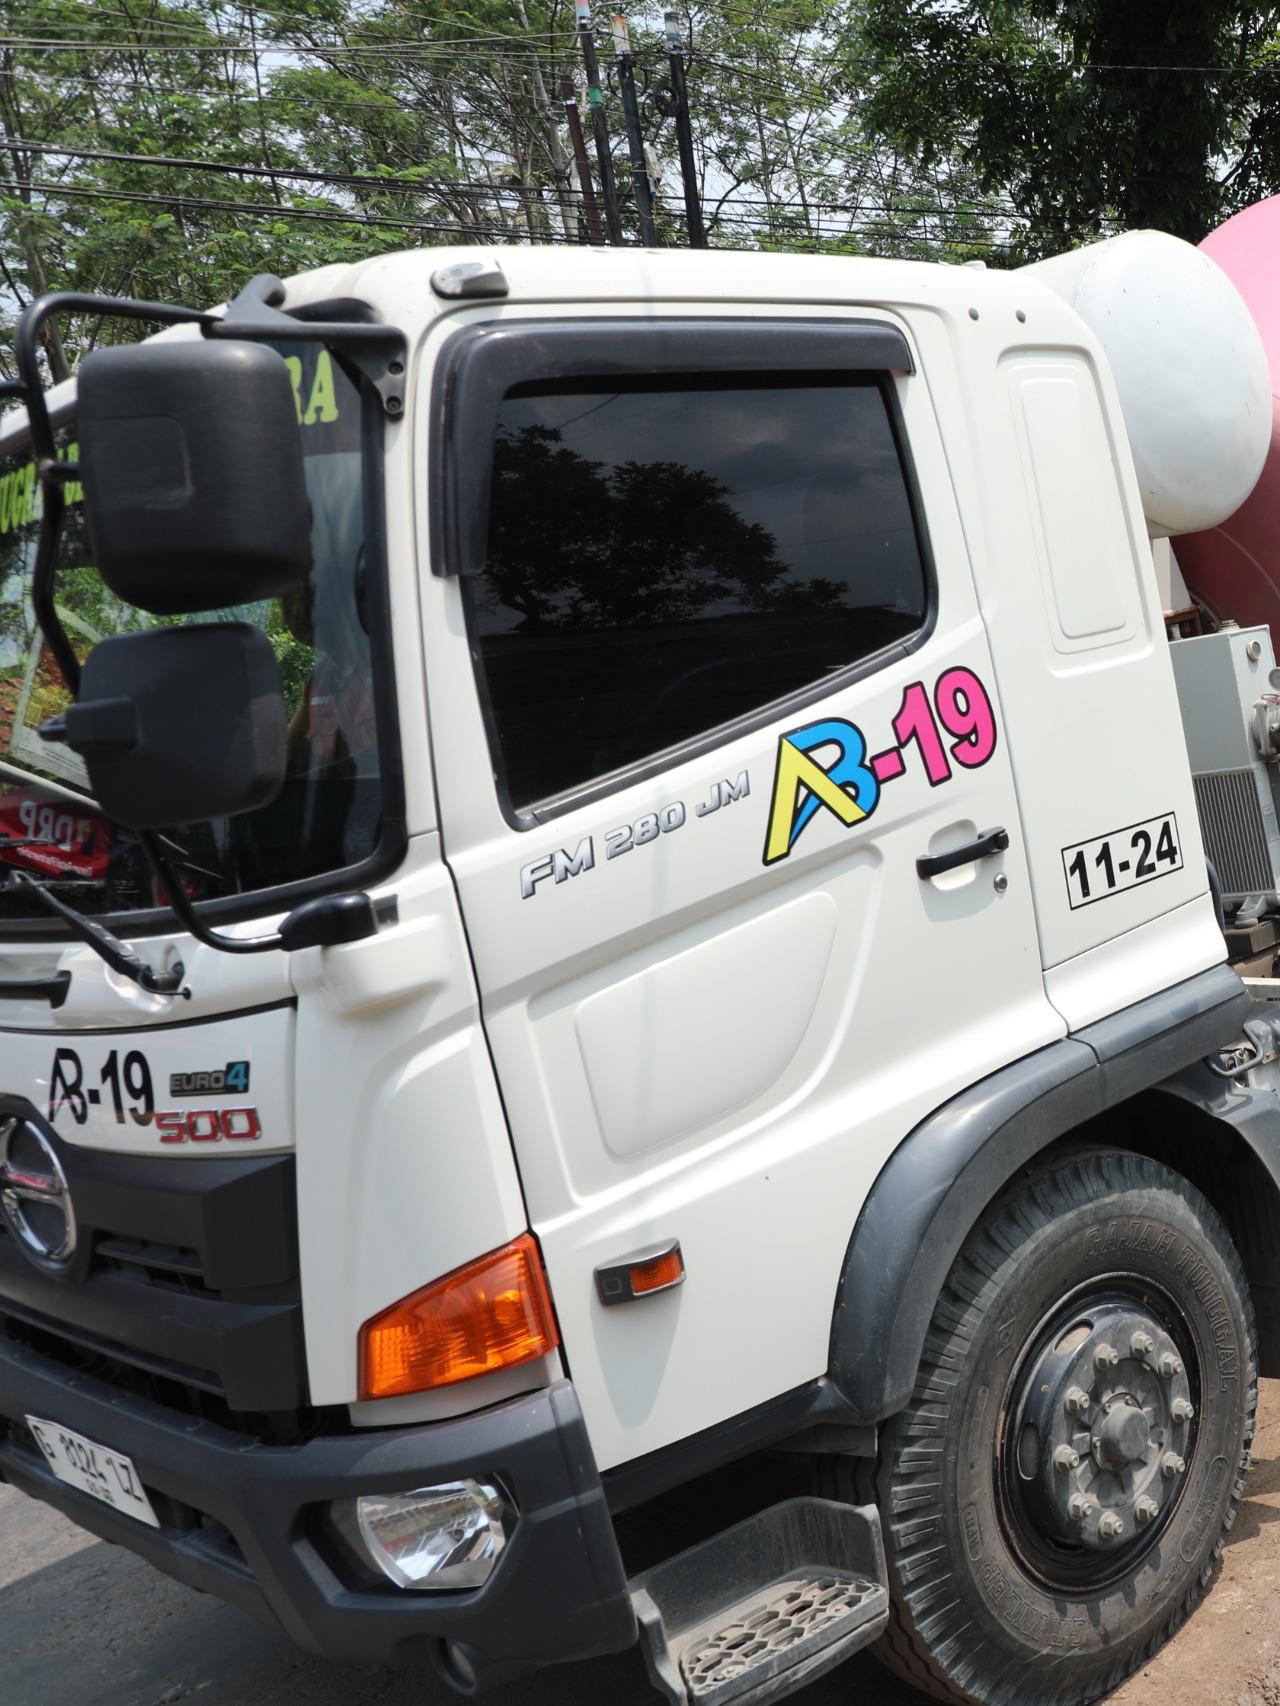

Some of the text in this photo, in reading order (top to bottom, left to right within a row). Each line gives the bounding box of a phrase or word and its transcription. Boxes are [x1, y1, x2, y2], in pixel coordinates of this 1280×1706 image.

[521, 770, 751, 900] FM 280 JM
[1069, 820, 1179, 899] 11-24
[154, 1106, 262, 1144] 500
[1083, 1221, 1239, 1393] GAJAH TUNGGAL
